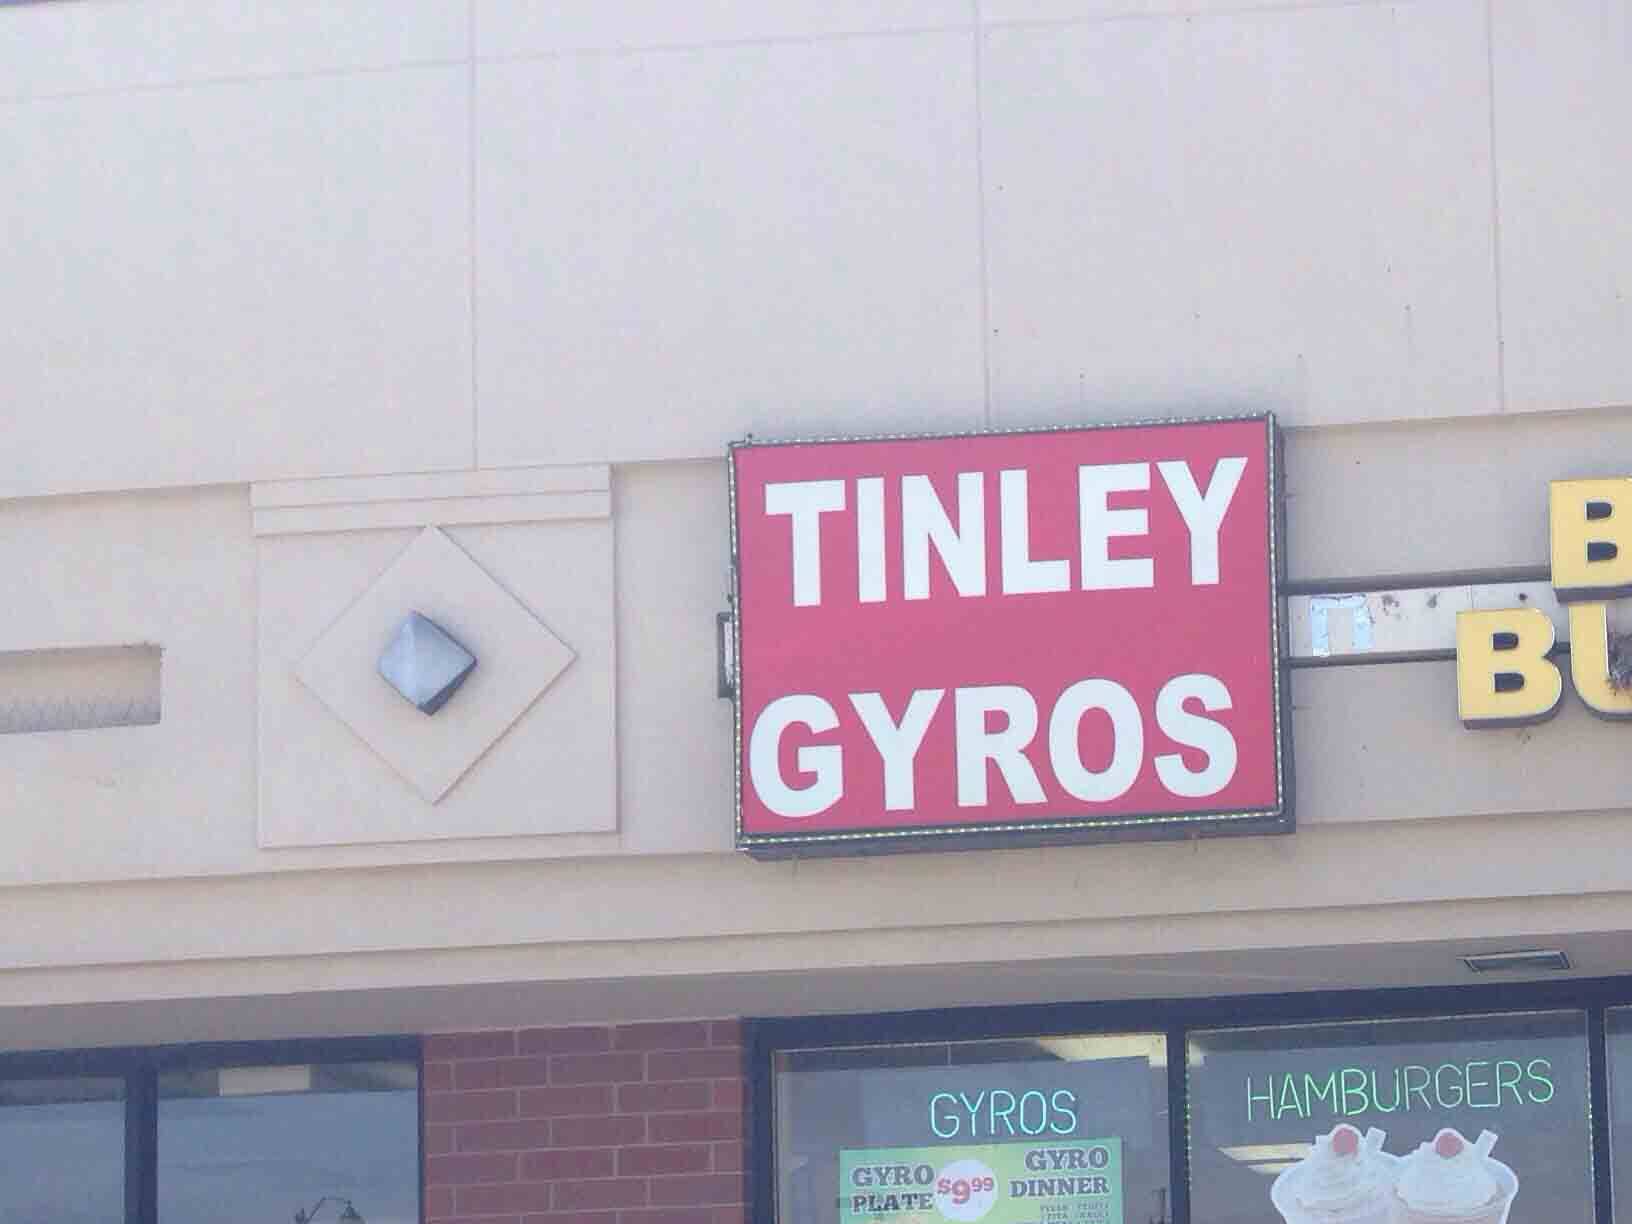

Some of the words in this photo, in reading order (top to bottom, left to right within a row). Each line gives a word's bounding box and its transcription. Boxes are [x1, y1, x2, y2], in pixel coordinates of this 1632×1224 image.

[765, 457, 1248, 607] TINLEY
[749, 673, 1238, 818] GYROS
[1246, 1058, 1554, 1122] HAMBURGERS
[930, 1089, 1077, 1138] GYROS
[851, 1163, 936, 1188] GYRO
[1024, 1146, 1110, 1172] GYRO
[852, 1192, 934, 1213] PLATE
[1009, 1177, 1110, 1199] DINNER
